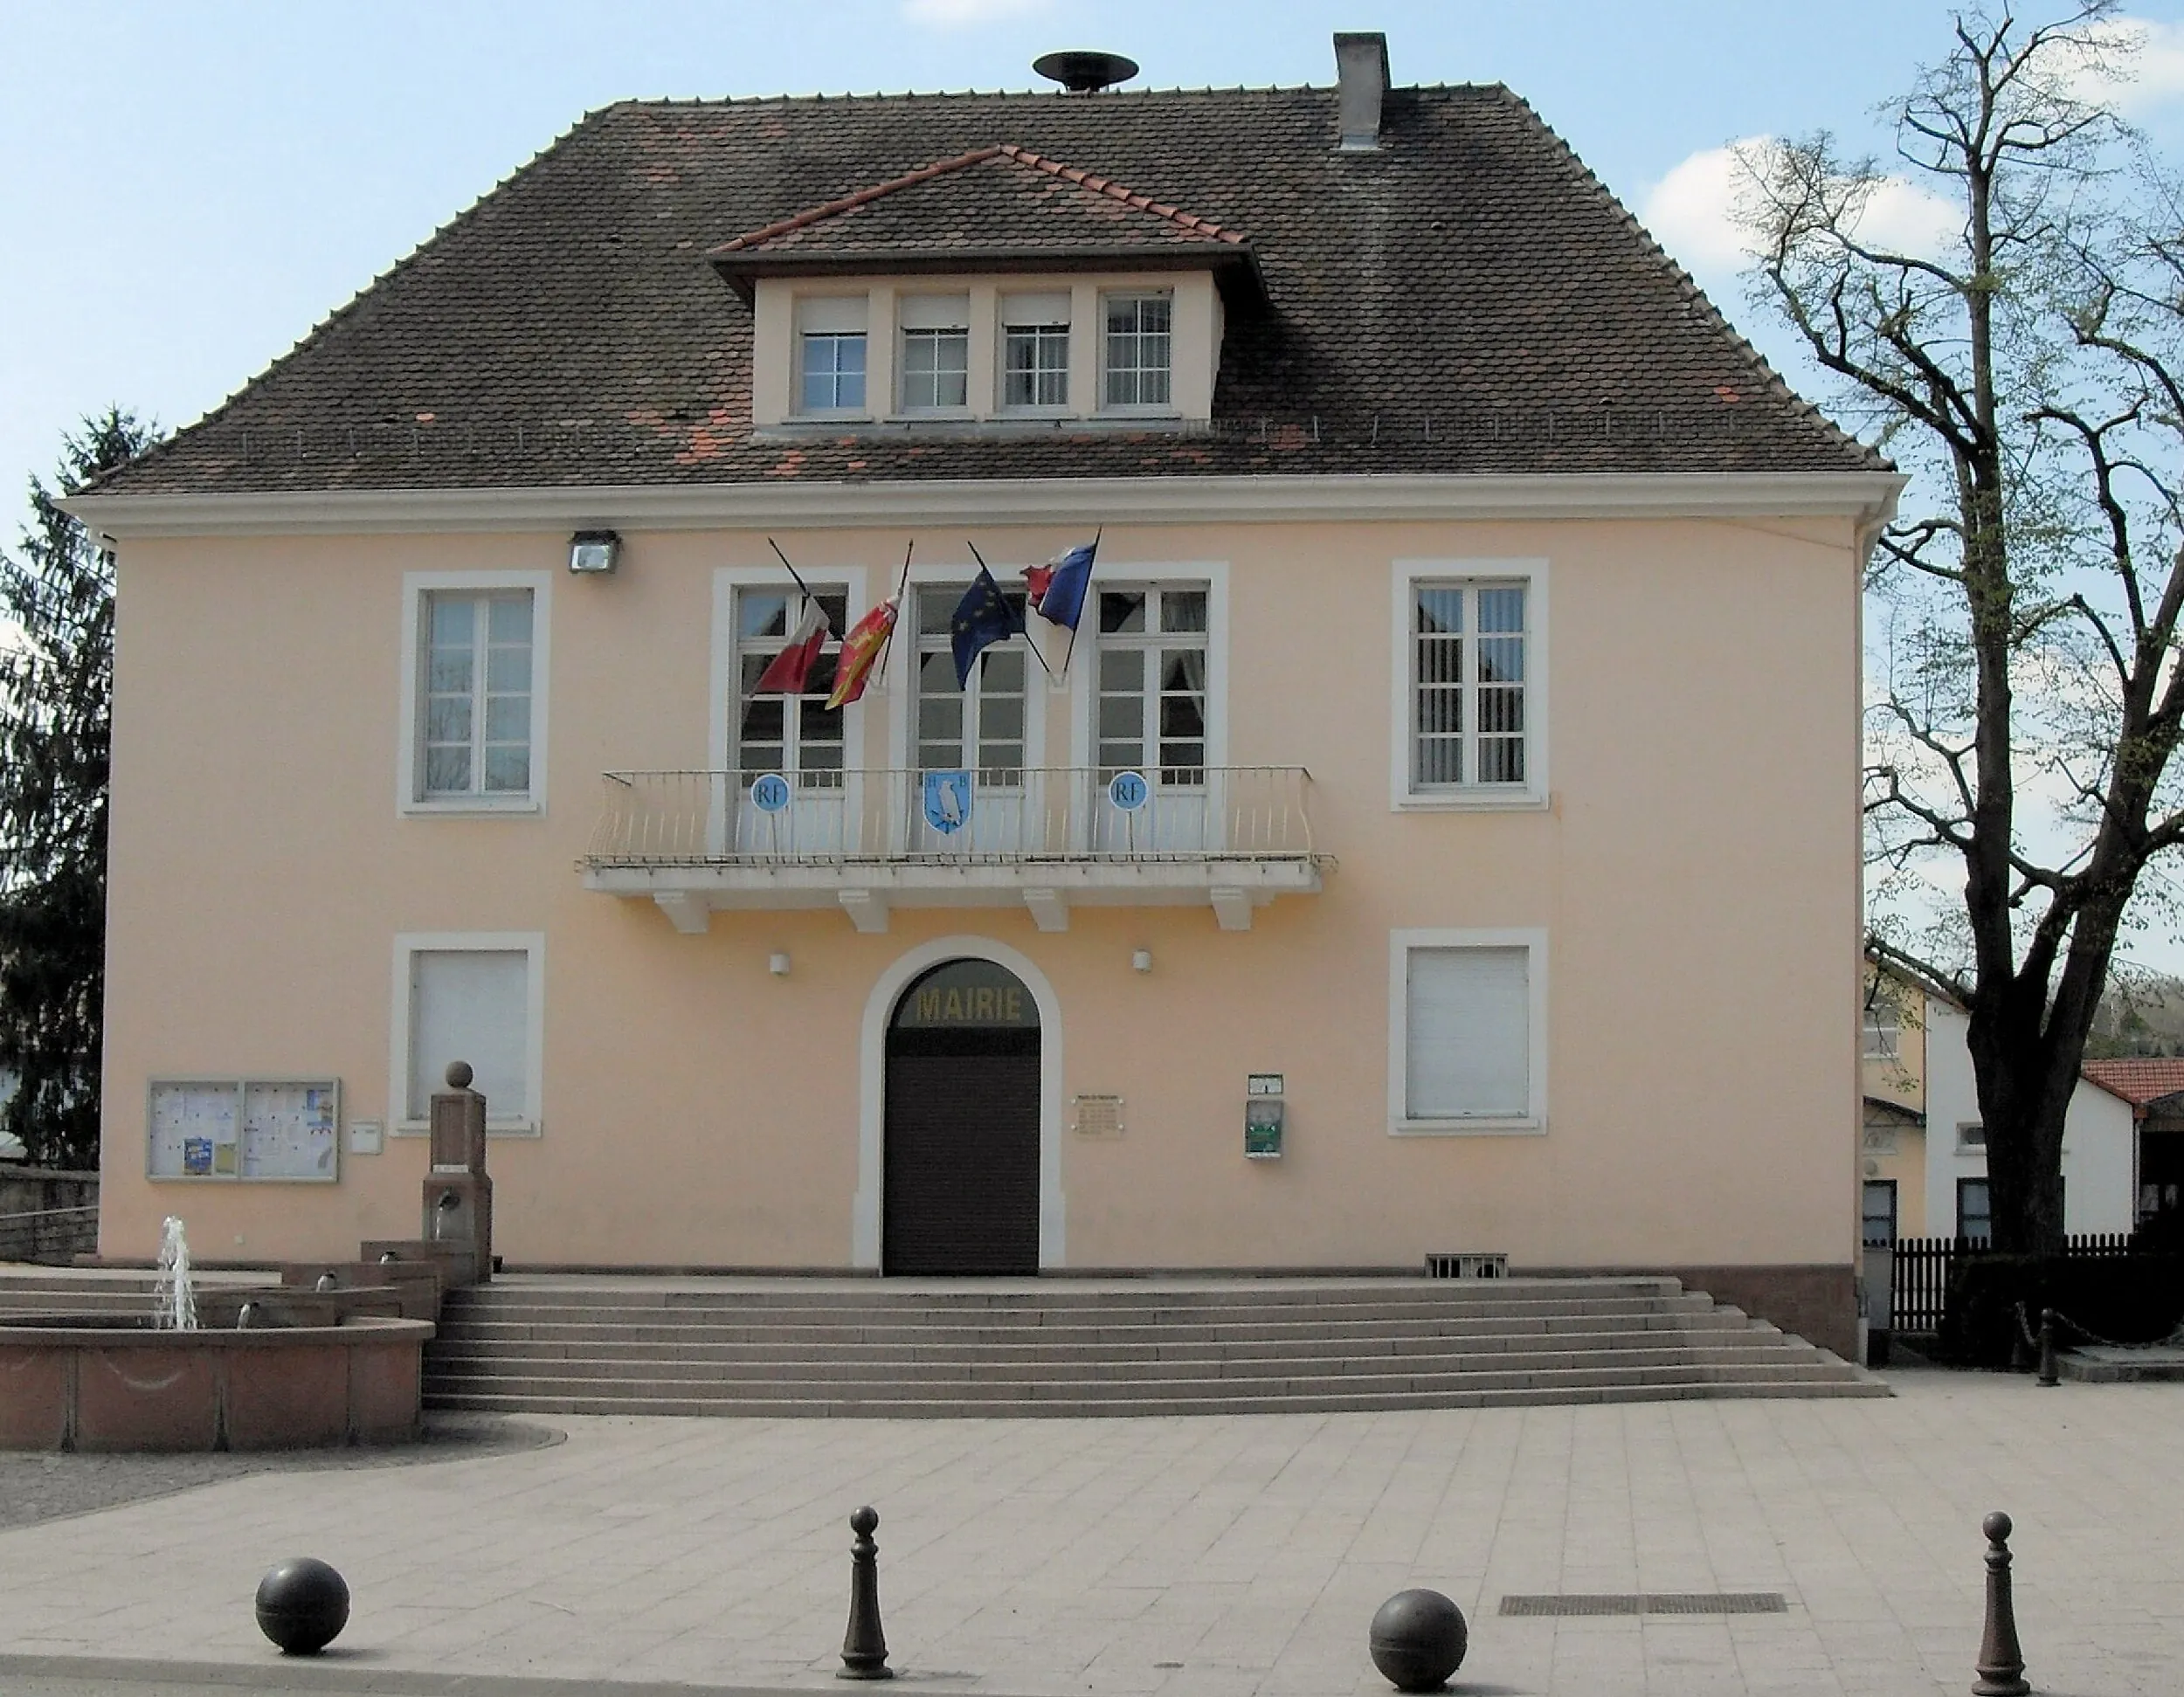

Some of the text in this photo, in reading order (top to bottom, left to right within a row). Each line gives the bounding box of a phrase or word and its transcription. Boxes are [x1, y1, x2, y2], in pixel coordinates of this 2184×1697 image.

[757, 784, 782, 804] RF
[1116, 783, 1139, 802] RF
[916, 988, 1021, 1020] MAIRIE
